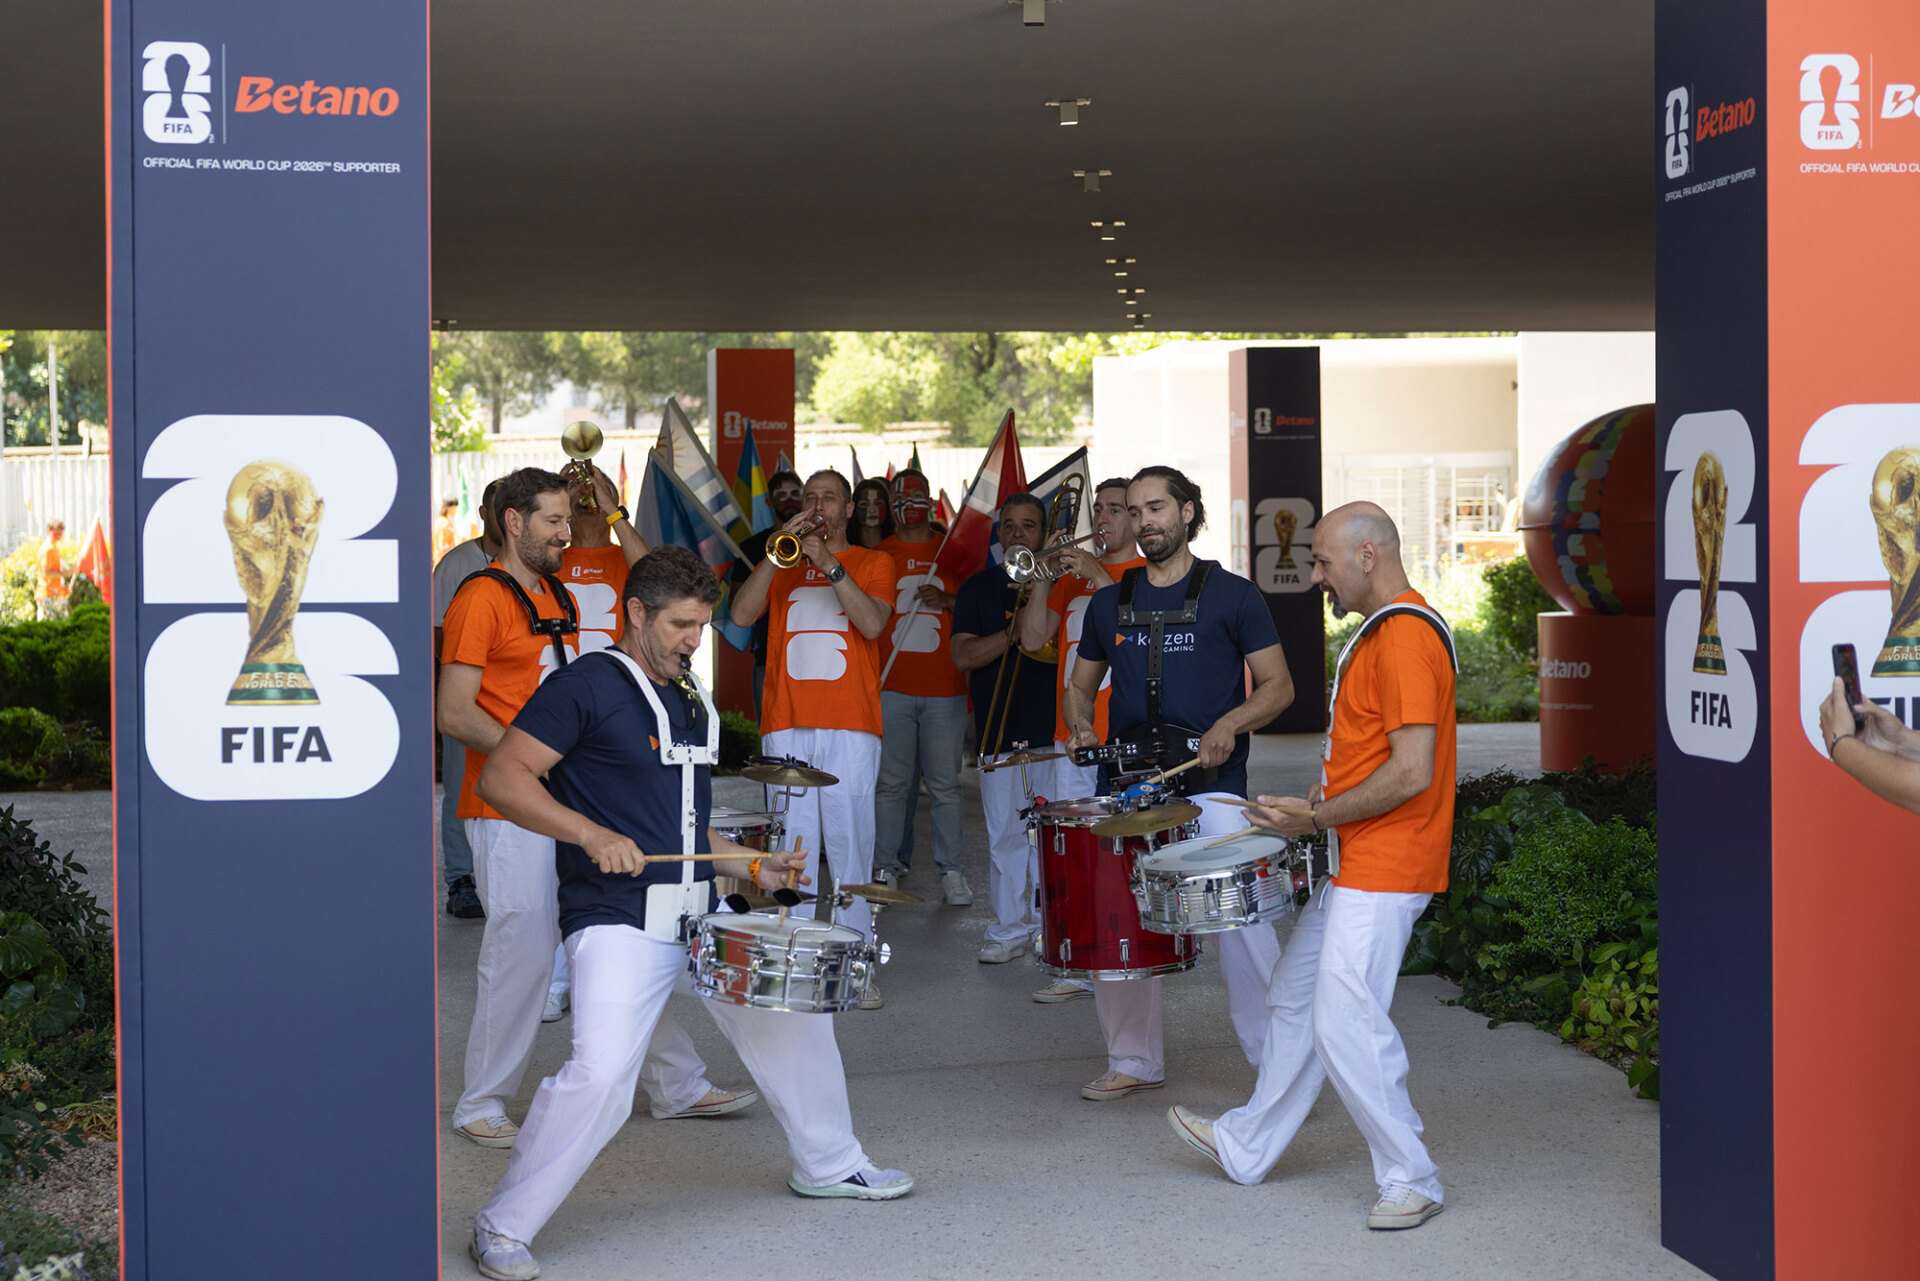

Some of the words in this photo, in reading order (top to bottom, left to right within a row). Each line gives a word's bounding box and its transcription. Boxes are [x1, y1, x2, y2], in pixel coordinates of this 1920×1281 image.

[235, 76, 400, 117] Betano
[1880, 84, 1920, 119] B
[1696, 97, 1756, 142] Betano
[163, 123, 192, 134] FIFA
[1817, 130, 1844, 140] FIFA
[143, 157, 194, 168] OFFICIAL
[196, 158, 221, 169] FIFA
[222, 159, 265, 170] WORLD
[267, 160, 291, 171] CUP
[333, 161, 400, 173] SUPPORTER
[1672, 159, 1683, 170] FIFA
[1799, 163, 1844, 173] OFFICIAL
[1846, 163, 1868, 173] FIFA
[1870, 163, 1907, 173] WORLD
[1273, 573, 1300, 585] FIFA
[1138, 633, 1194, 646] kzen
[1163, 645, 1194, 653] GAMING
[1690, 690, 1733, 729] FIFA
[220, 726, 333, 763] FIFA
